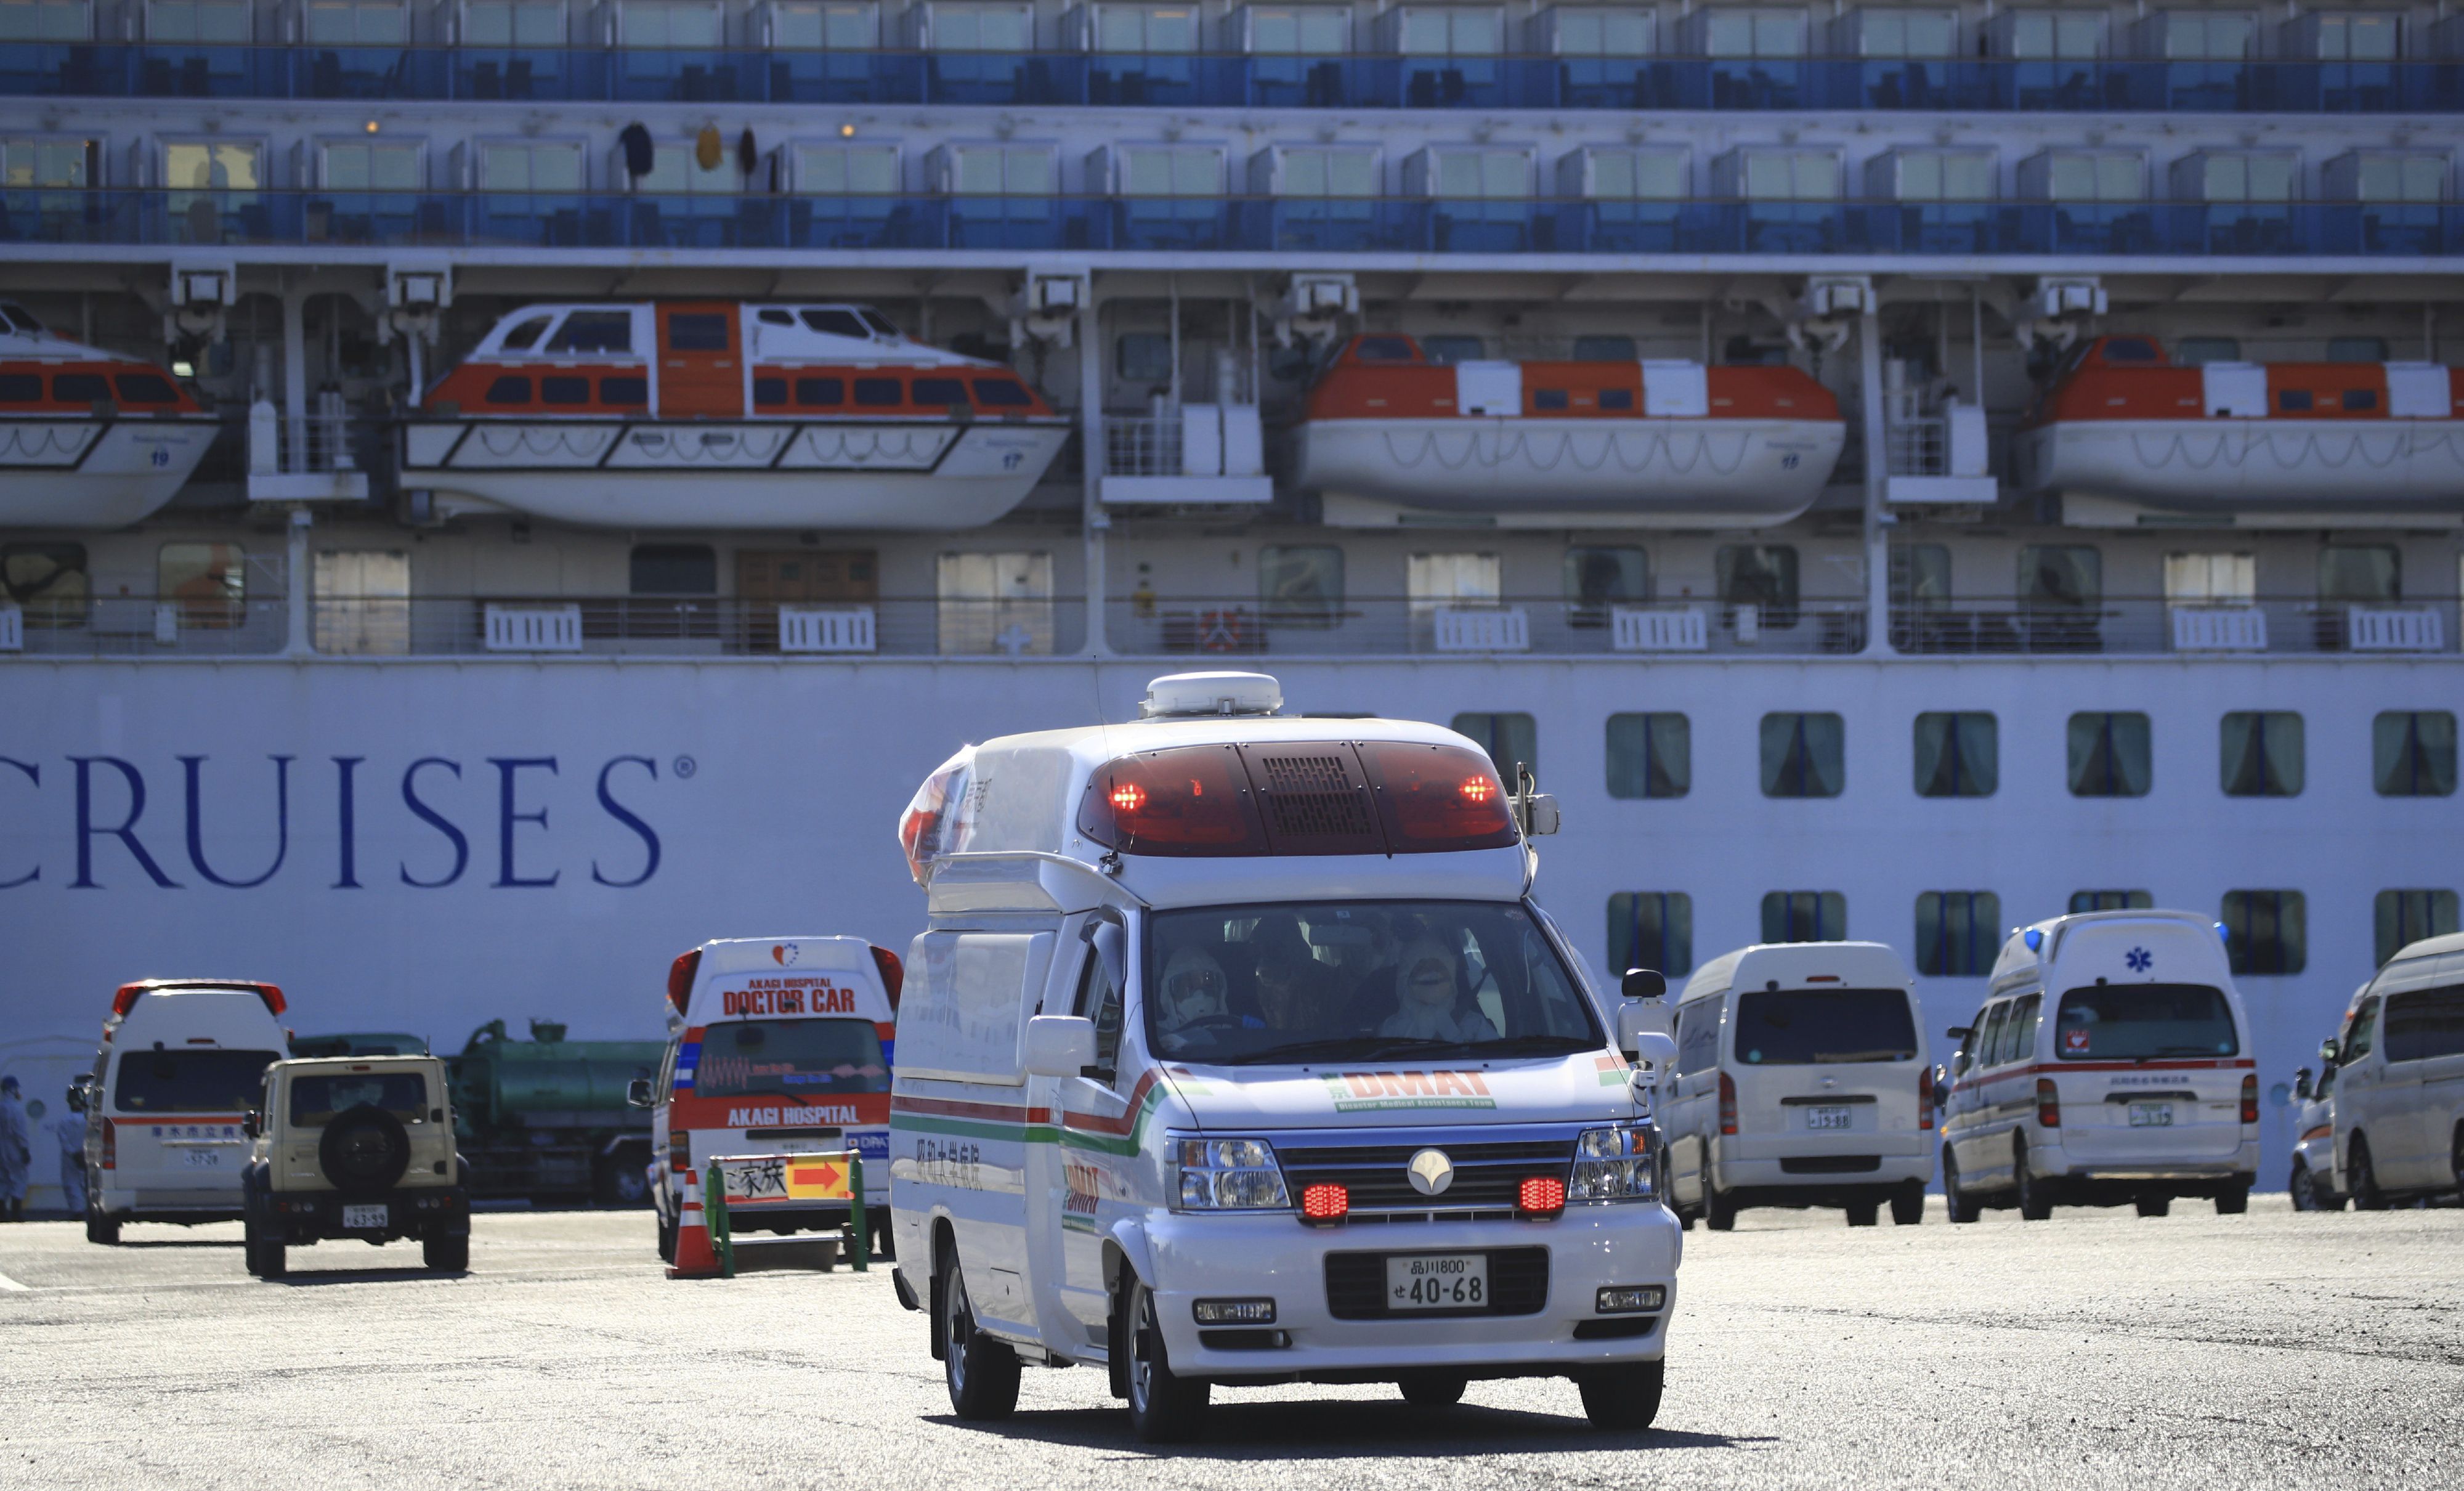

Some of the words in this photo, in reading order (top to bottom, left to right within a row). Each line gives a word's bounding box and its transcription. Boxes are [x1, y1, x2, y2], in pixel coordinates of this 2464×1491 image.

[748, 978, 781, 989] AKAGI
[784, 977, 832, 988] HOSPITAL
[723, 989, 805, 1016] DOCTOR
[812, 988, 856, 1013] CAR
[1342, 1070, 1491, 1099] DMAT
[727, 1107, 780, 1127] AKAGI
[783, 1105, 861, 1125] HOSPITAL
[1339, 1102, 1377, 1110] Disaster
[1380, 1100, 1415, 1108] Medical
[1417, 1099, 1467, 1107] Assistance
[1469, 1099, 1493, 1107] Team
[1393, 1285, 1406, 1298] せ
[1410, 1277, 1483, 1304] 40-68
